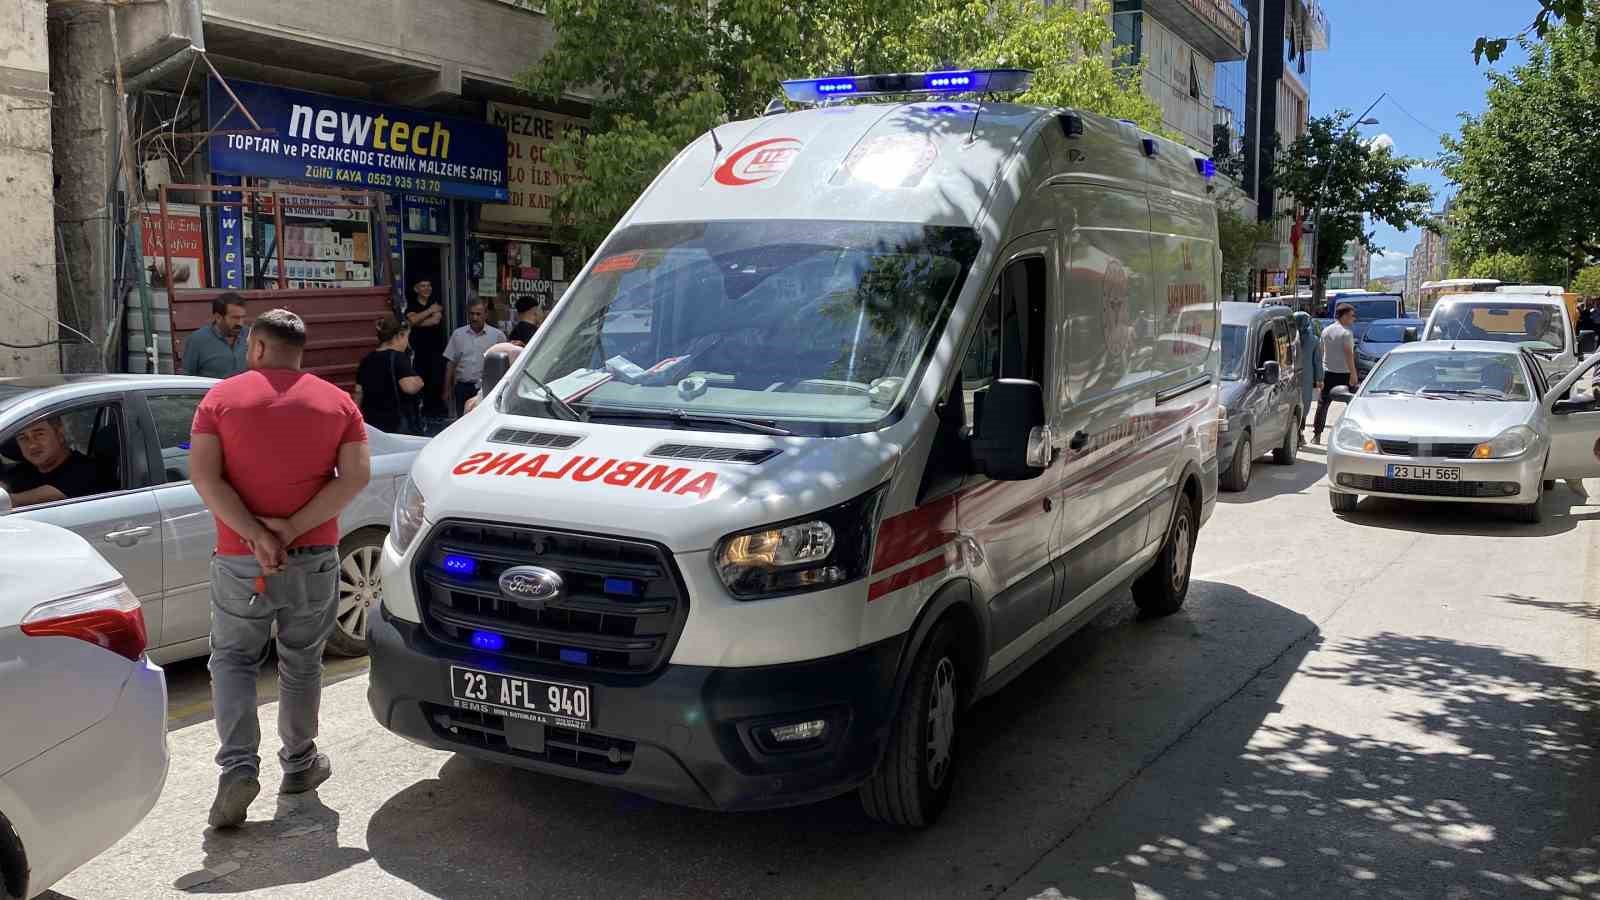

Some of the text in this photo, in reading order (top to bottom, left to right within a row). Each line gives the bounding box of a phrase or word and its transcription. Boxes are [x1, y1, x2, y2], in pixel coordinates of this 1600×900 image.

[288, 103, 451, 159] newtech
[227, 133, 502, 186] TOPTAN ve PERAKENDE TEKNİK MALZEME SATIŞI
[335, 168, 362, 183] KAYA
[367, 172, 392, 187] 0552
[394, 175, 413, 190] 935
[1394, 466, 1409, 478] 23
[1413, 467, 1431, 480] LH
[1436, 468, 1459, 481] 565
[508, 575, 544, 595] Ford
[464, 672, 586, 717] 23 AFL 940
